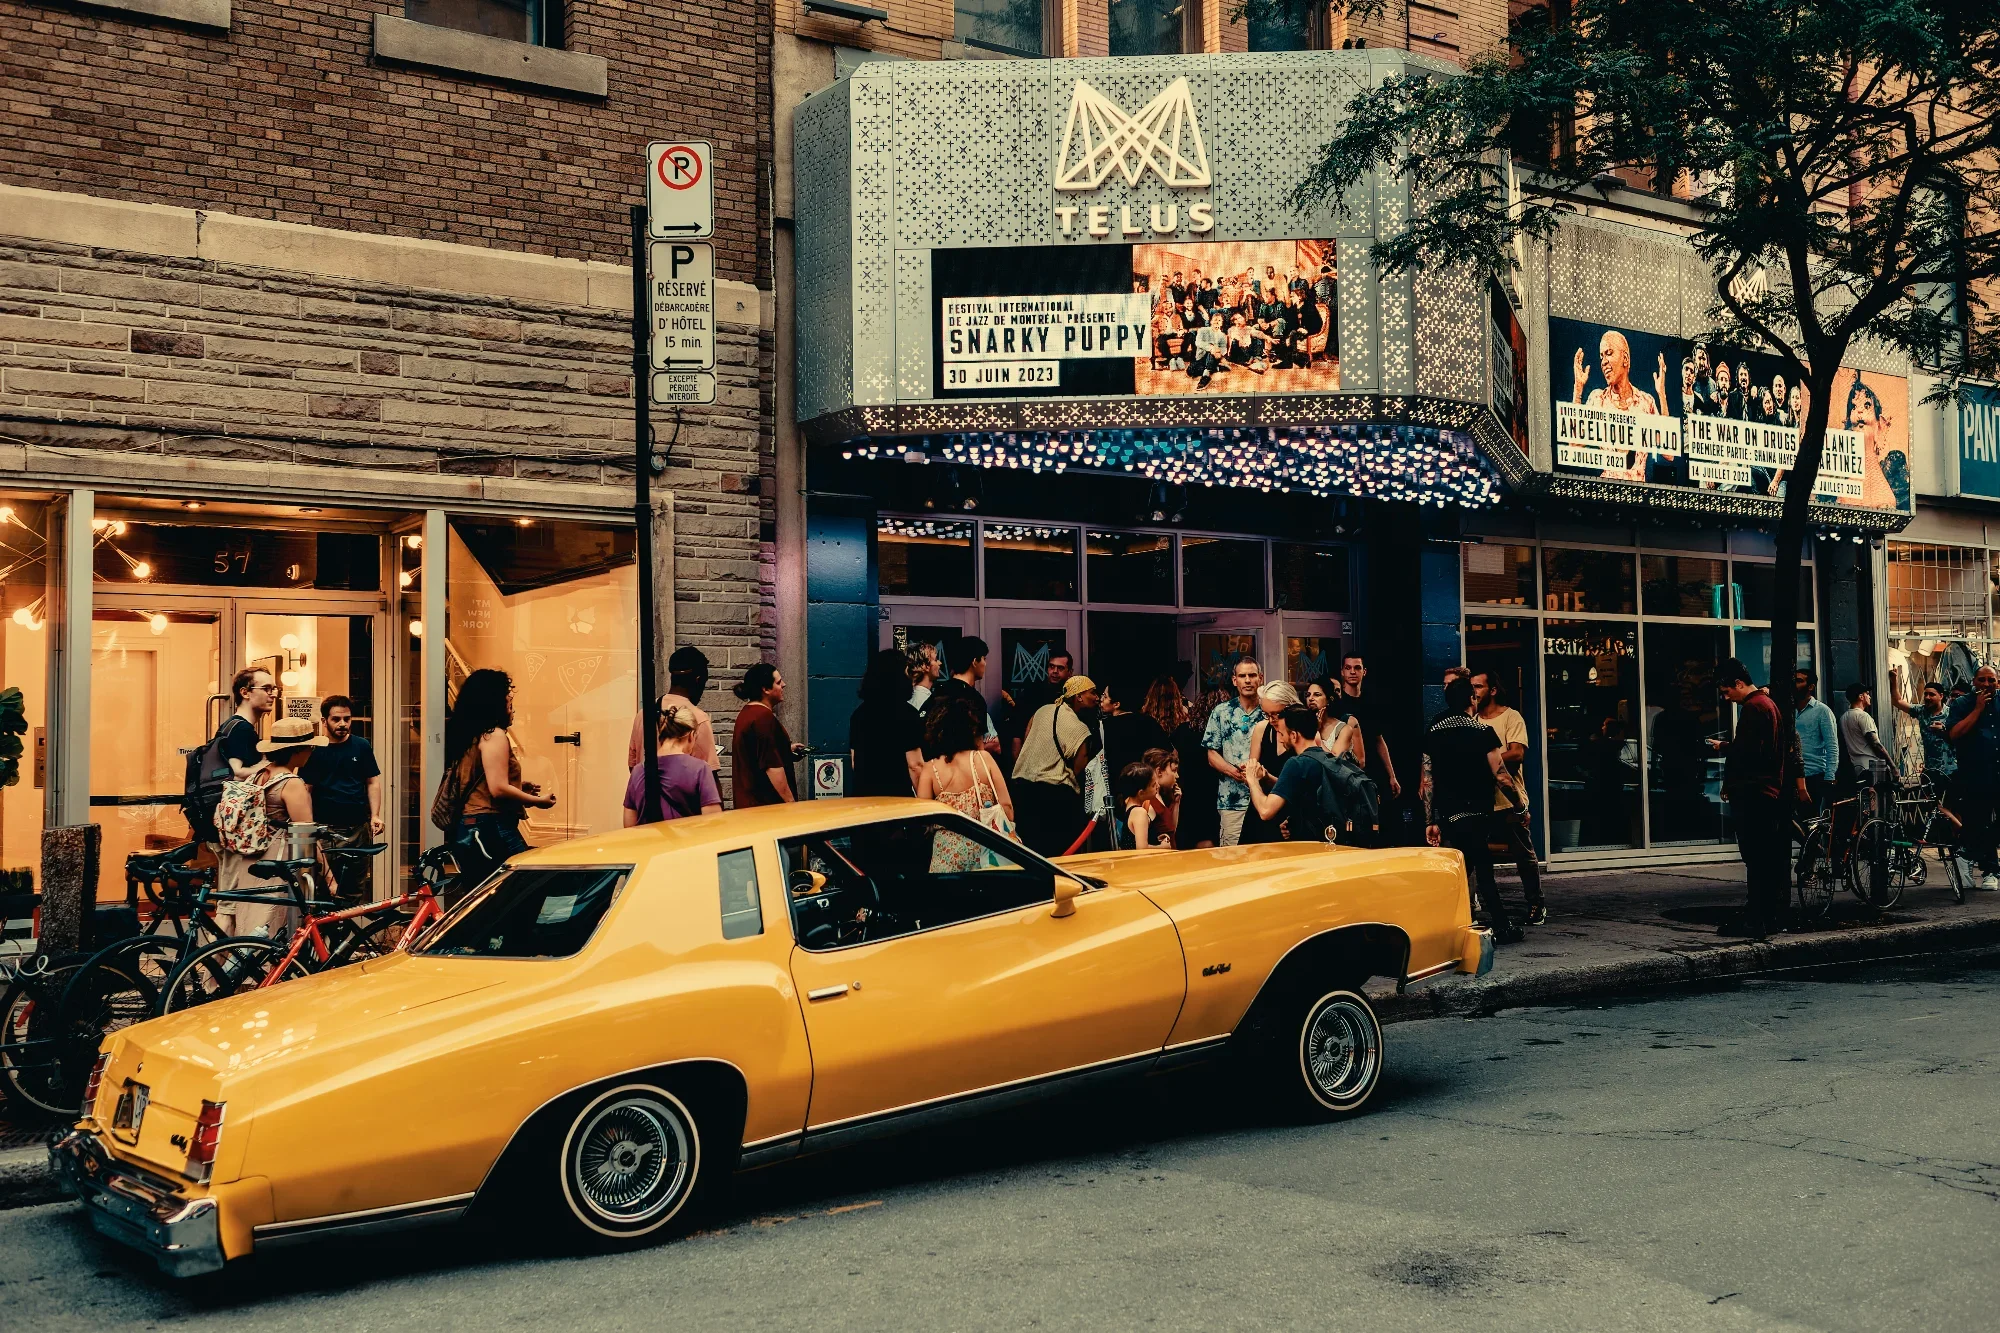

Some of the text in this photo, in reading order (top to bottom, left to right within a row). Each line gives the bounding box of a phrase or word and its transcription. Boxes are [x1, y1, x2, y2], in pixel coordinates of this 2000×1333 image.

[674, 156, 690, 179] P
[1054, 202, 1215, 237] TELUS
[671, 245, 694, 279] P
[657, 280, 707, 297] RÉSERVÉ
[654, 301, 711, 313] DÉBARCADÈRE
[948, 301, 1074, 314] FESTIVAL INTERNATIONAL
[671, 315, 707, 331] HÔTEL
[948, 311, 1116, 327] DE JAZZ DE MONTRÉAL PRÉSENTE
[665, 336, 676, 348] 15
[949, 324, 1146, 355] SNARKY PUPPY
[668, 374, 698, 383] EXCEPTÉ
[949, 366, 1054, 385] 30 JUIN 2023
[666, 392, 700, 401] INTERDITE
[669, 383, 698, 392] PÉRIODE
[1560, 417, 1678, 451] ANGELIQUE KIDJO
[1691, 420, 1797, 452] THE WAR ON DRUGS
[1692, 441, 1725, 458] PREMIÈRE
[1825, 433, 1856, 455] LANIE
[1560, 449, 1624, 468] 12 JUILLET 2023
[1819, 452, 1863, 475] ARTINEZ
[1691, 465, 1749, 483] 14 JUILLET 2023
[1819, 480, 1844, 494] JUILLET
[1846, 484, 1861, 496] 2023
[214, 551, 250, 574] 57
